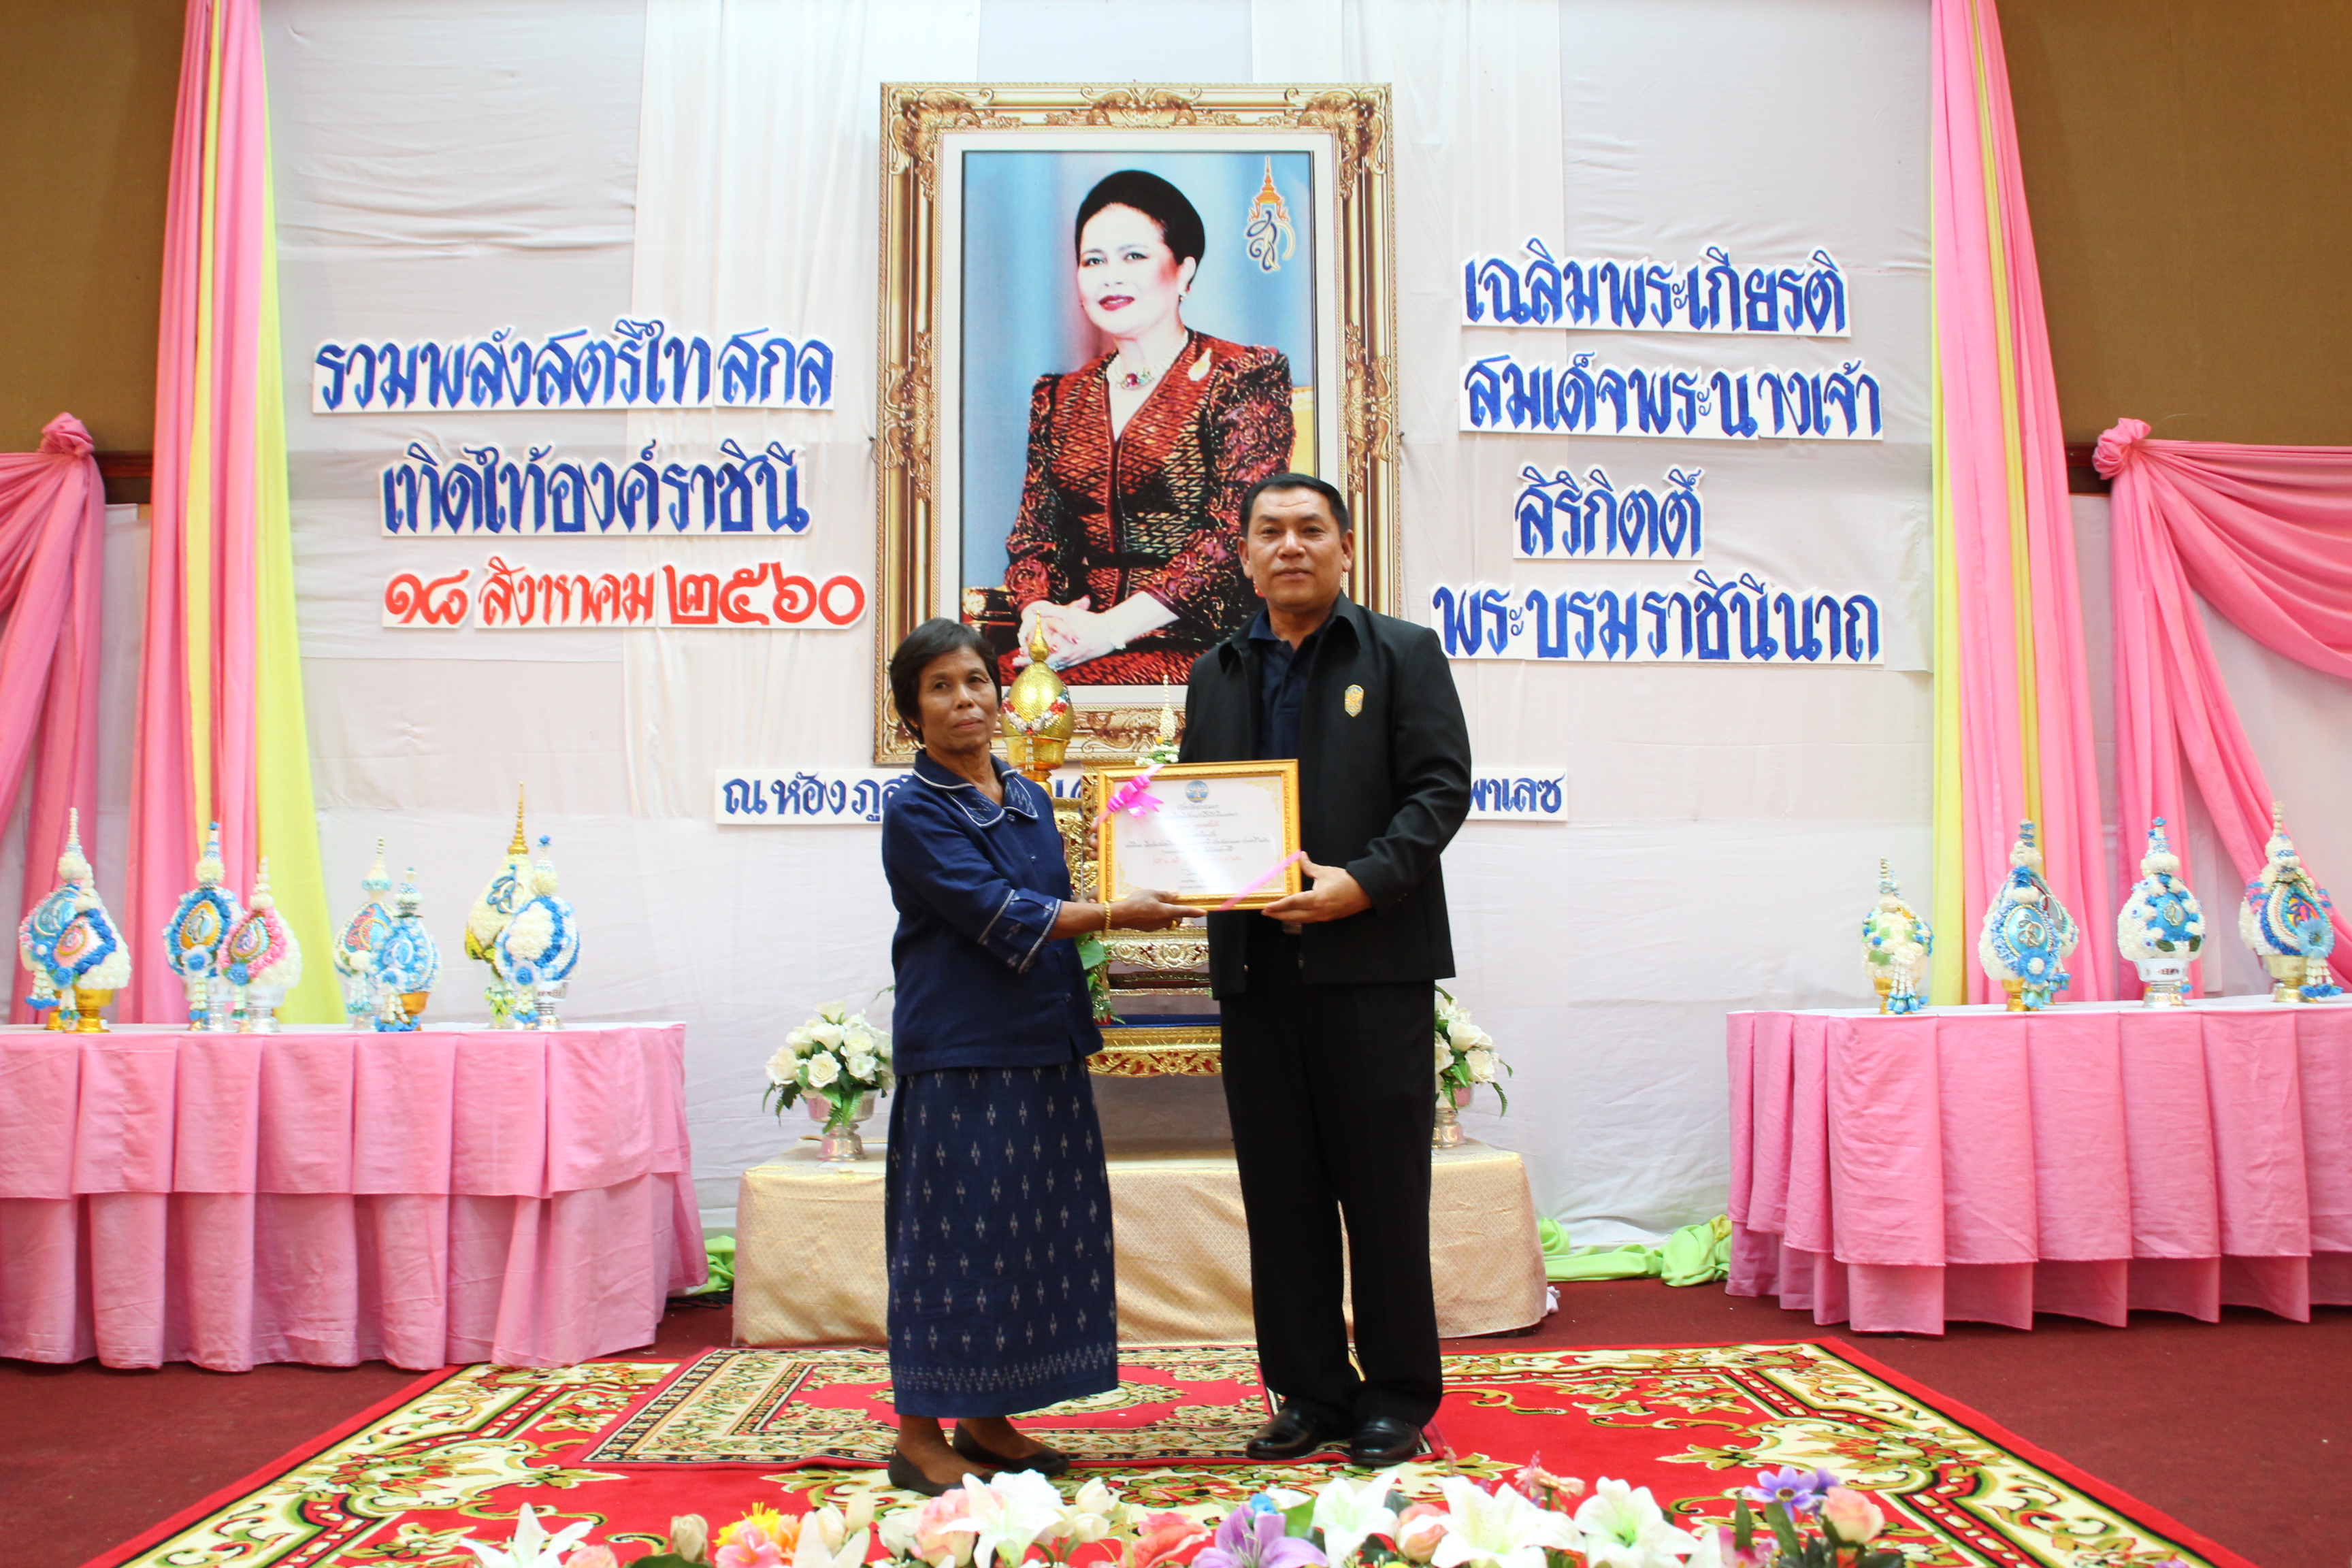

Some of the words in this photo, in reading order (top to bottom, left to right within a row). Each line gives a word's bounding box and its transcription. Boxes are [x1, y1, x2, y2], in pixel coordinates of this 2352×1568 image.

[1465, 237, 1846, 332] เฉลิมพระเกียรติ
[1466, 351, 1882, 438] สมเด็จพระนางเจ้า
[383, 438, 810, 534] เทิดไท้องค์ราชินี
[1515, 465, 1702, 558] สิริกิตติ์
[385, 569, 470, 625] ๑๘
[478, 555, 655, 626] สิงหาคม
[663, 561, 866, 625] ๒๕๖๐
[1433, 568, 1880, 662] พระบรมราชินีนาถ
